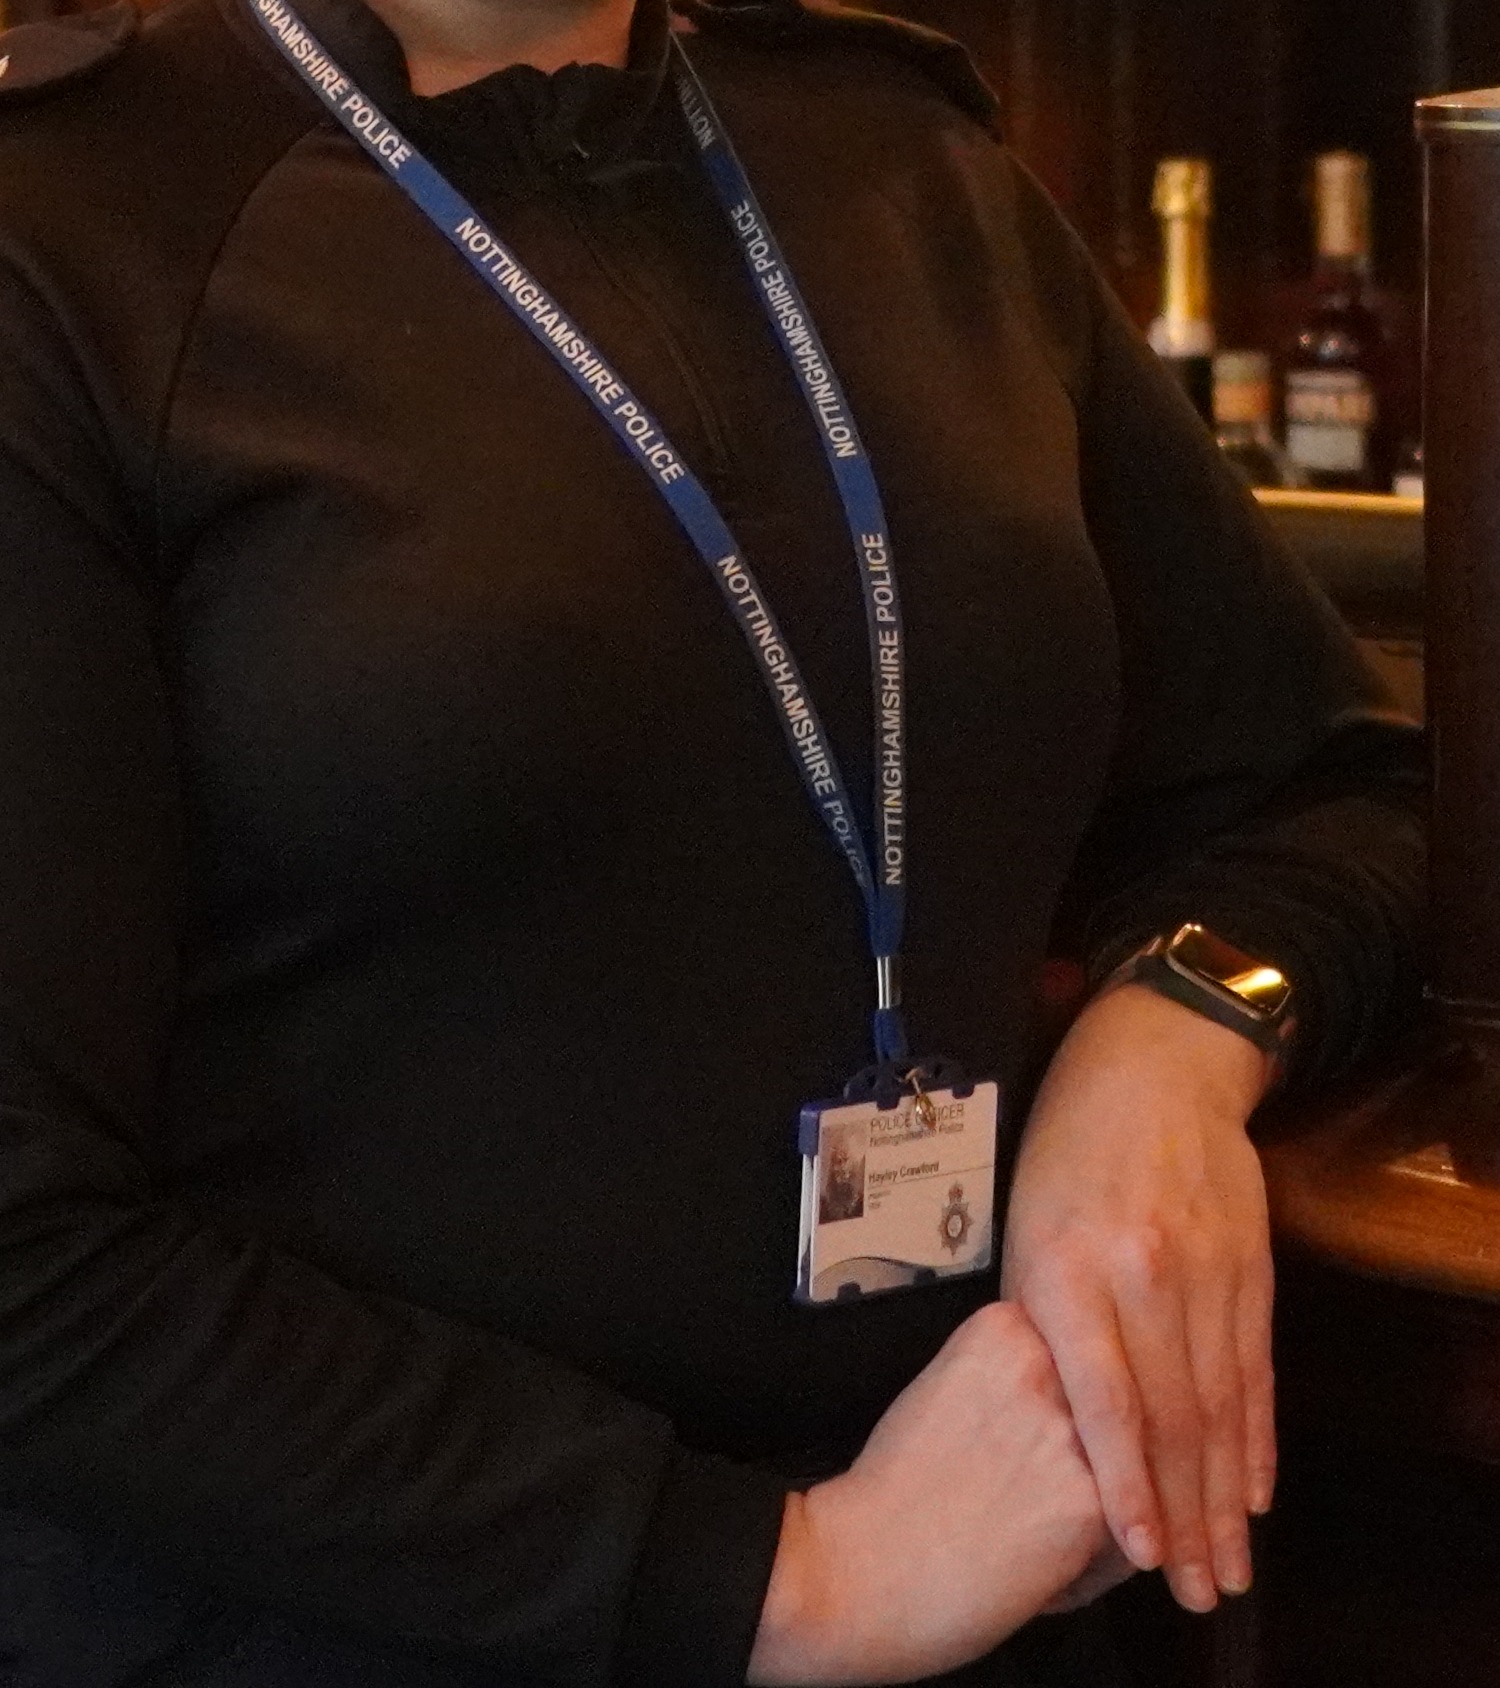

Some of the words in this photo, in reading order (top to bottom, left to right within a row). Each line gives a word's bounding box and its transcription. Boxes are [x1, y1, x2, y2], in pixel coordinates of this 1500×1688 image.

[342, 93, 413, 169] POLICE
[731, 200, 779, 273] POLICE
[454, 218, 624, 405] NOTTINGHAMSHIRE
[614, 397, 685, 485] POLICE
[761, 270, 857, 458] NOTTINGHAMSHIRE
[862, 533, 897, 622] POLICE
[717, 556, 836, 797] NOTTINGHAMSHIRE
[879, 630, 903, 885] NOTTINGHAMSHIRE
[915, 1104, 964, 1124] OICER
